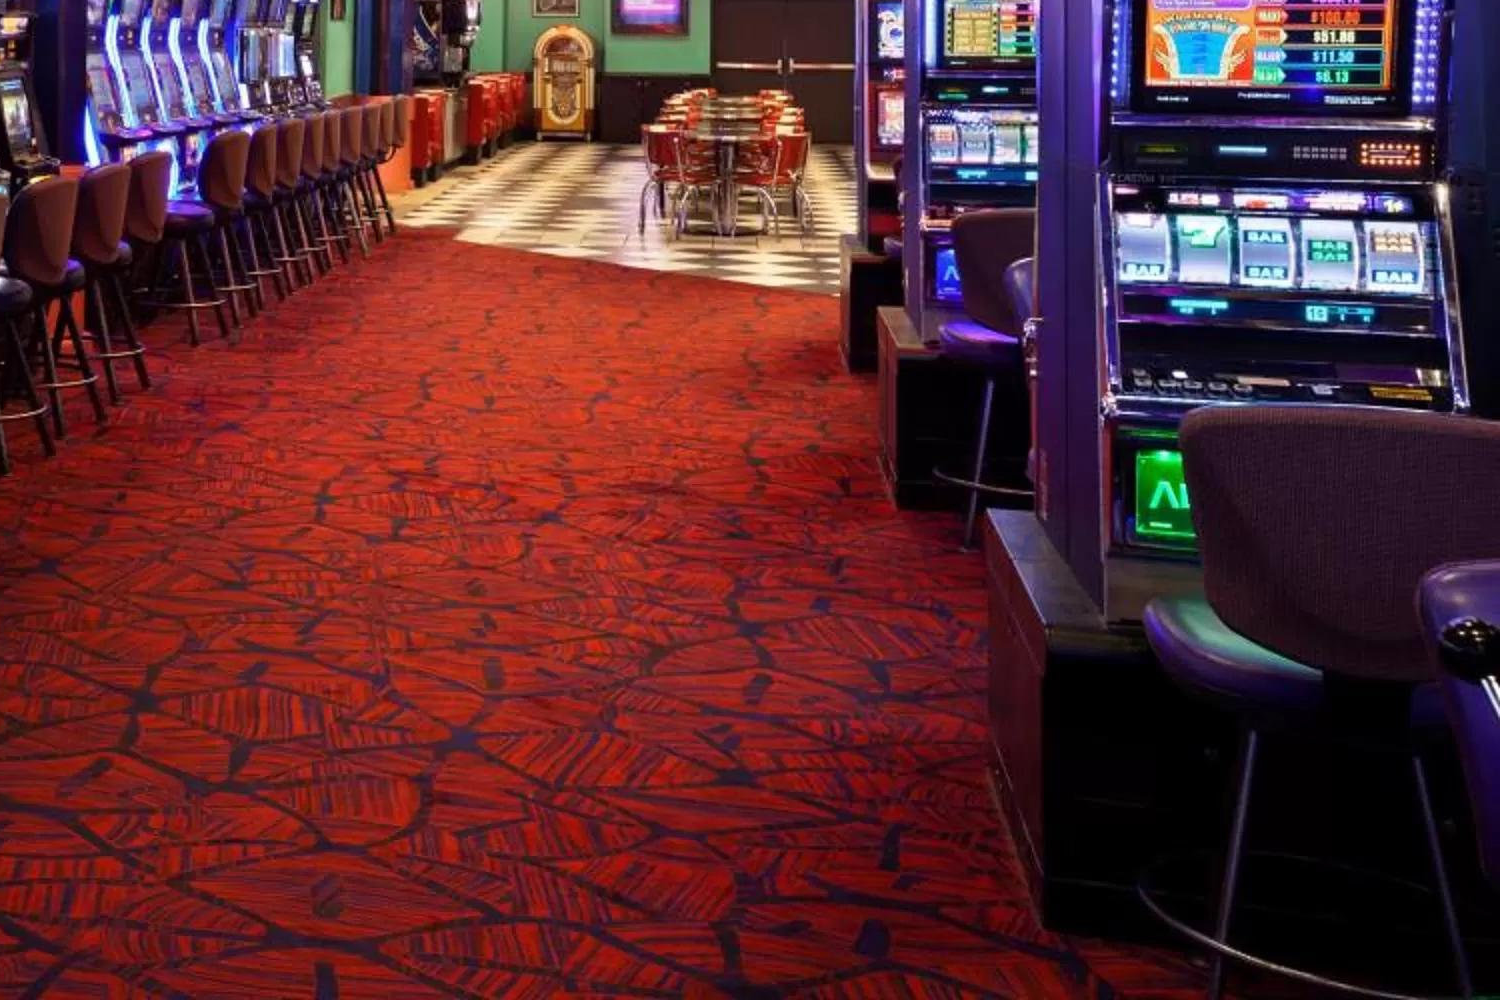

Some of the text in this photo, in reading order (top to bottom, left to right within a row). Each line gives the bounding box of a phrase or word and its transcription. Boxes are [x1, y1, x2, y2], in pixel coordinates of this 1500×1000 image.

[1247, 231, 1285, 243] BAR
[1126, 264, 1163, 277] BAR
[1248, 266, 1285, 280] BAR
[1375, 271, 1414, 283] BAR
